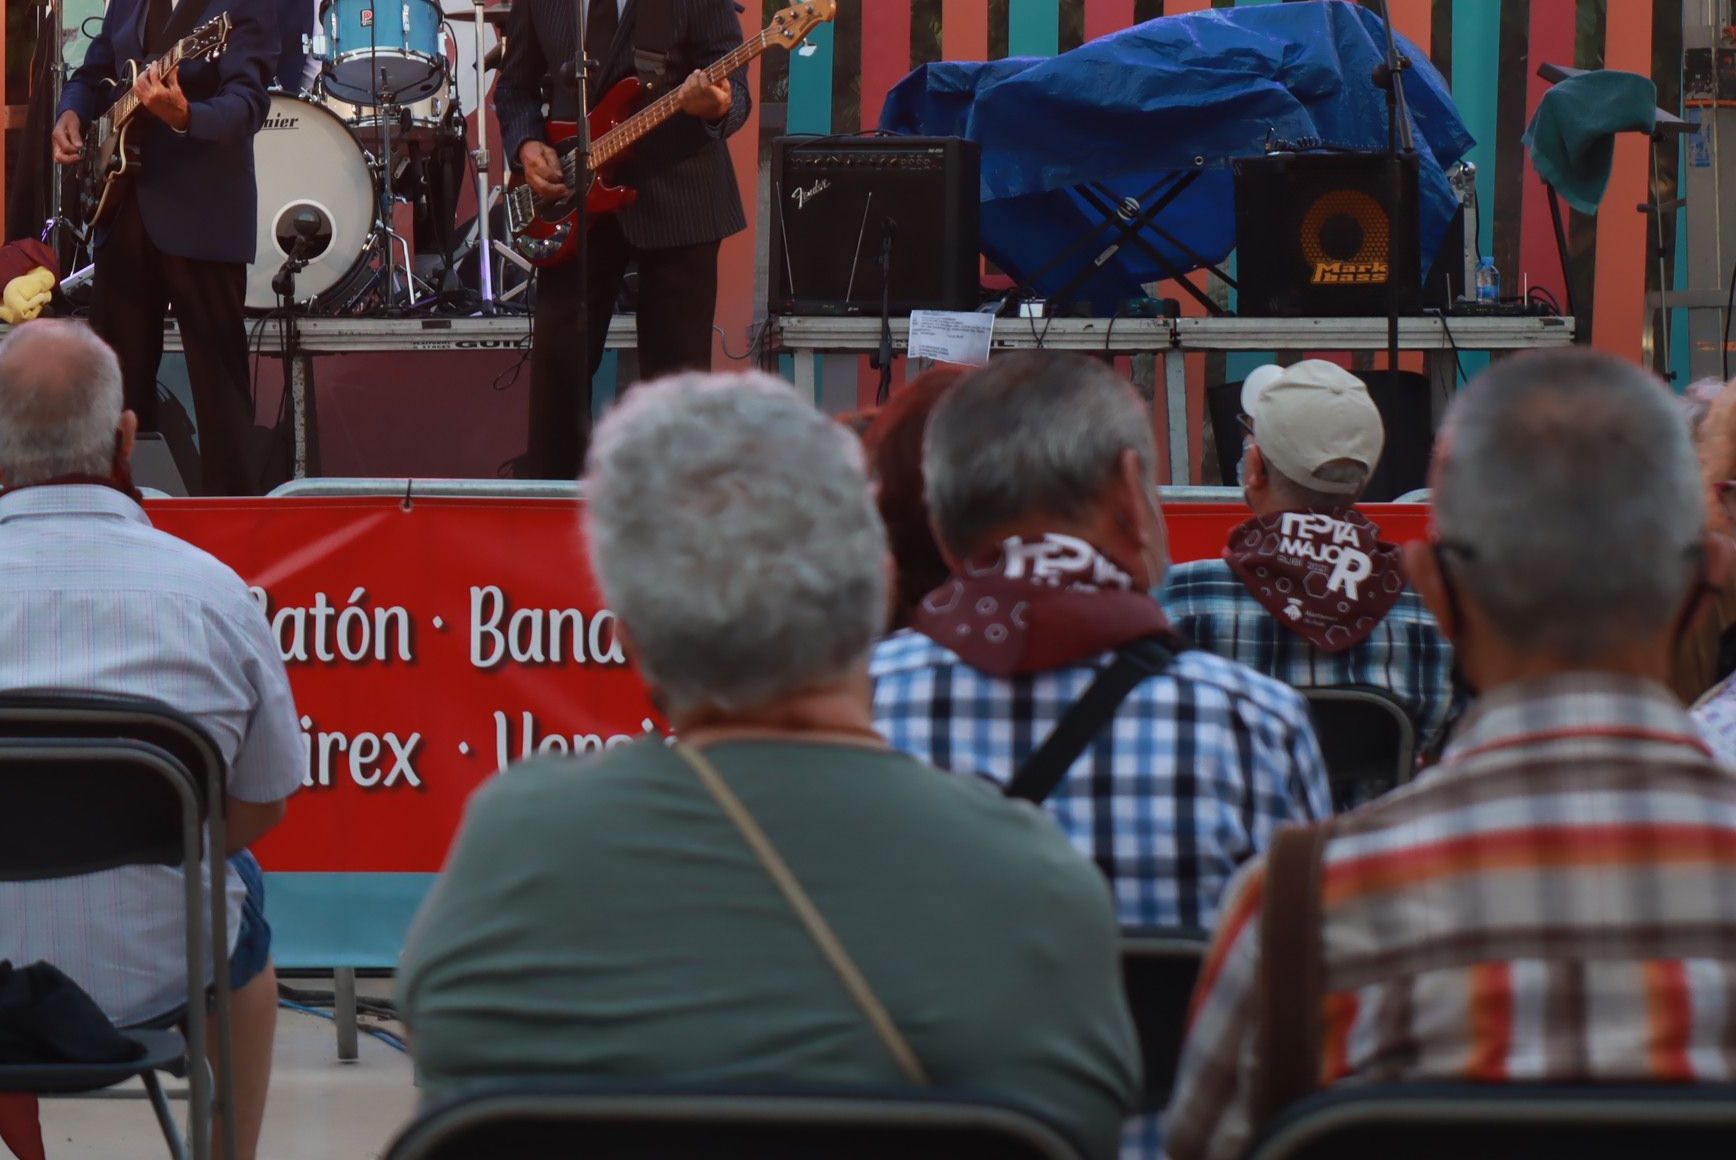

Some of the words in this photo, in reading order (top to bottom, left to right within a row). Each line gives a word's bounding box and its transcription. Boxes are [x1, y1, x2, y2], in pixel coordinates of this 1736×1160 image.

[791, 179, 831, 210] Fender
[1312, 262, 1389, 280] Mark
[1323, 272, 1387, 284] bass
[1278, 537, 1373, 601] MAJOR
